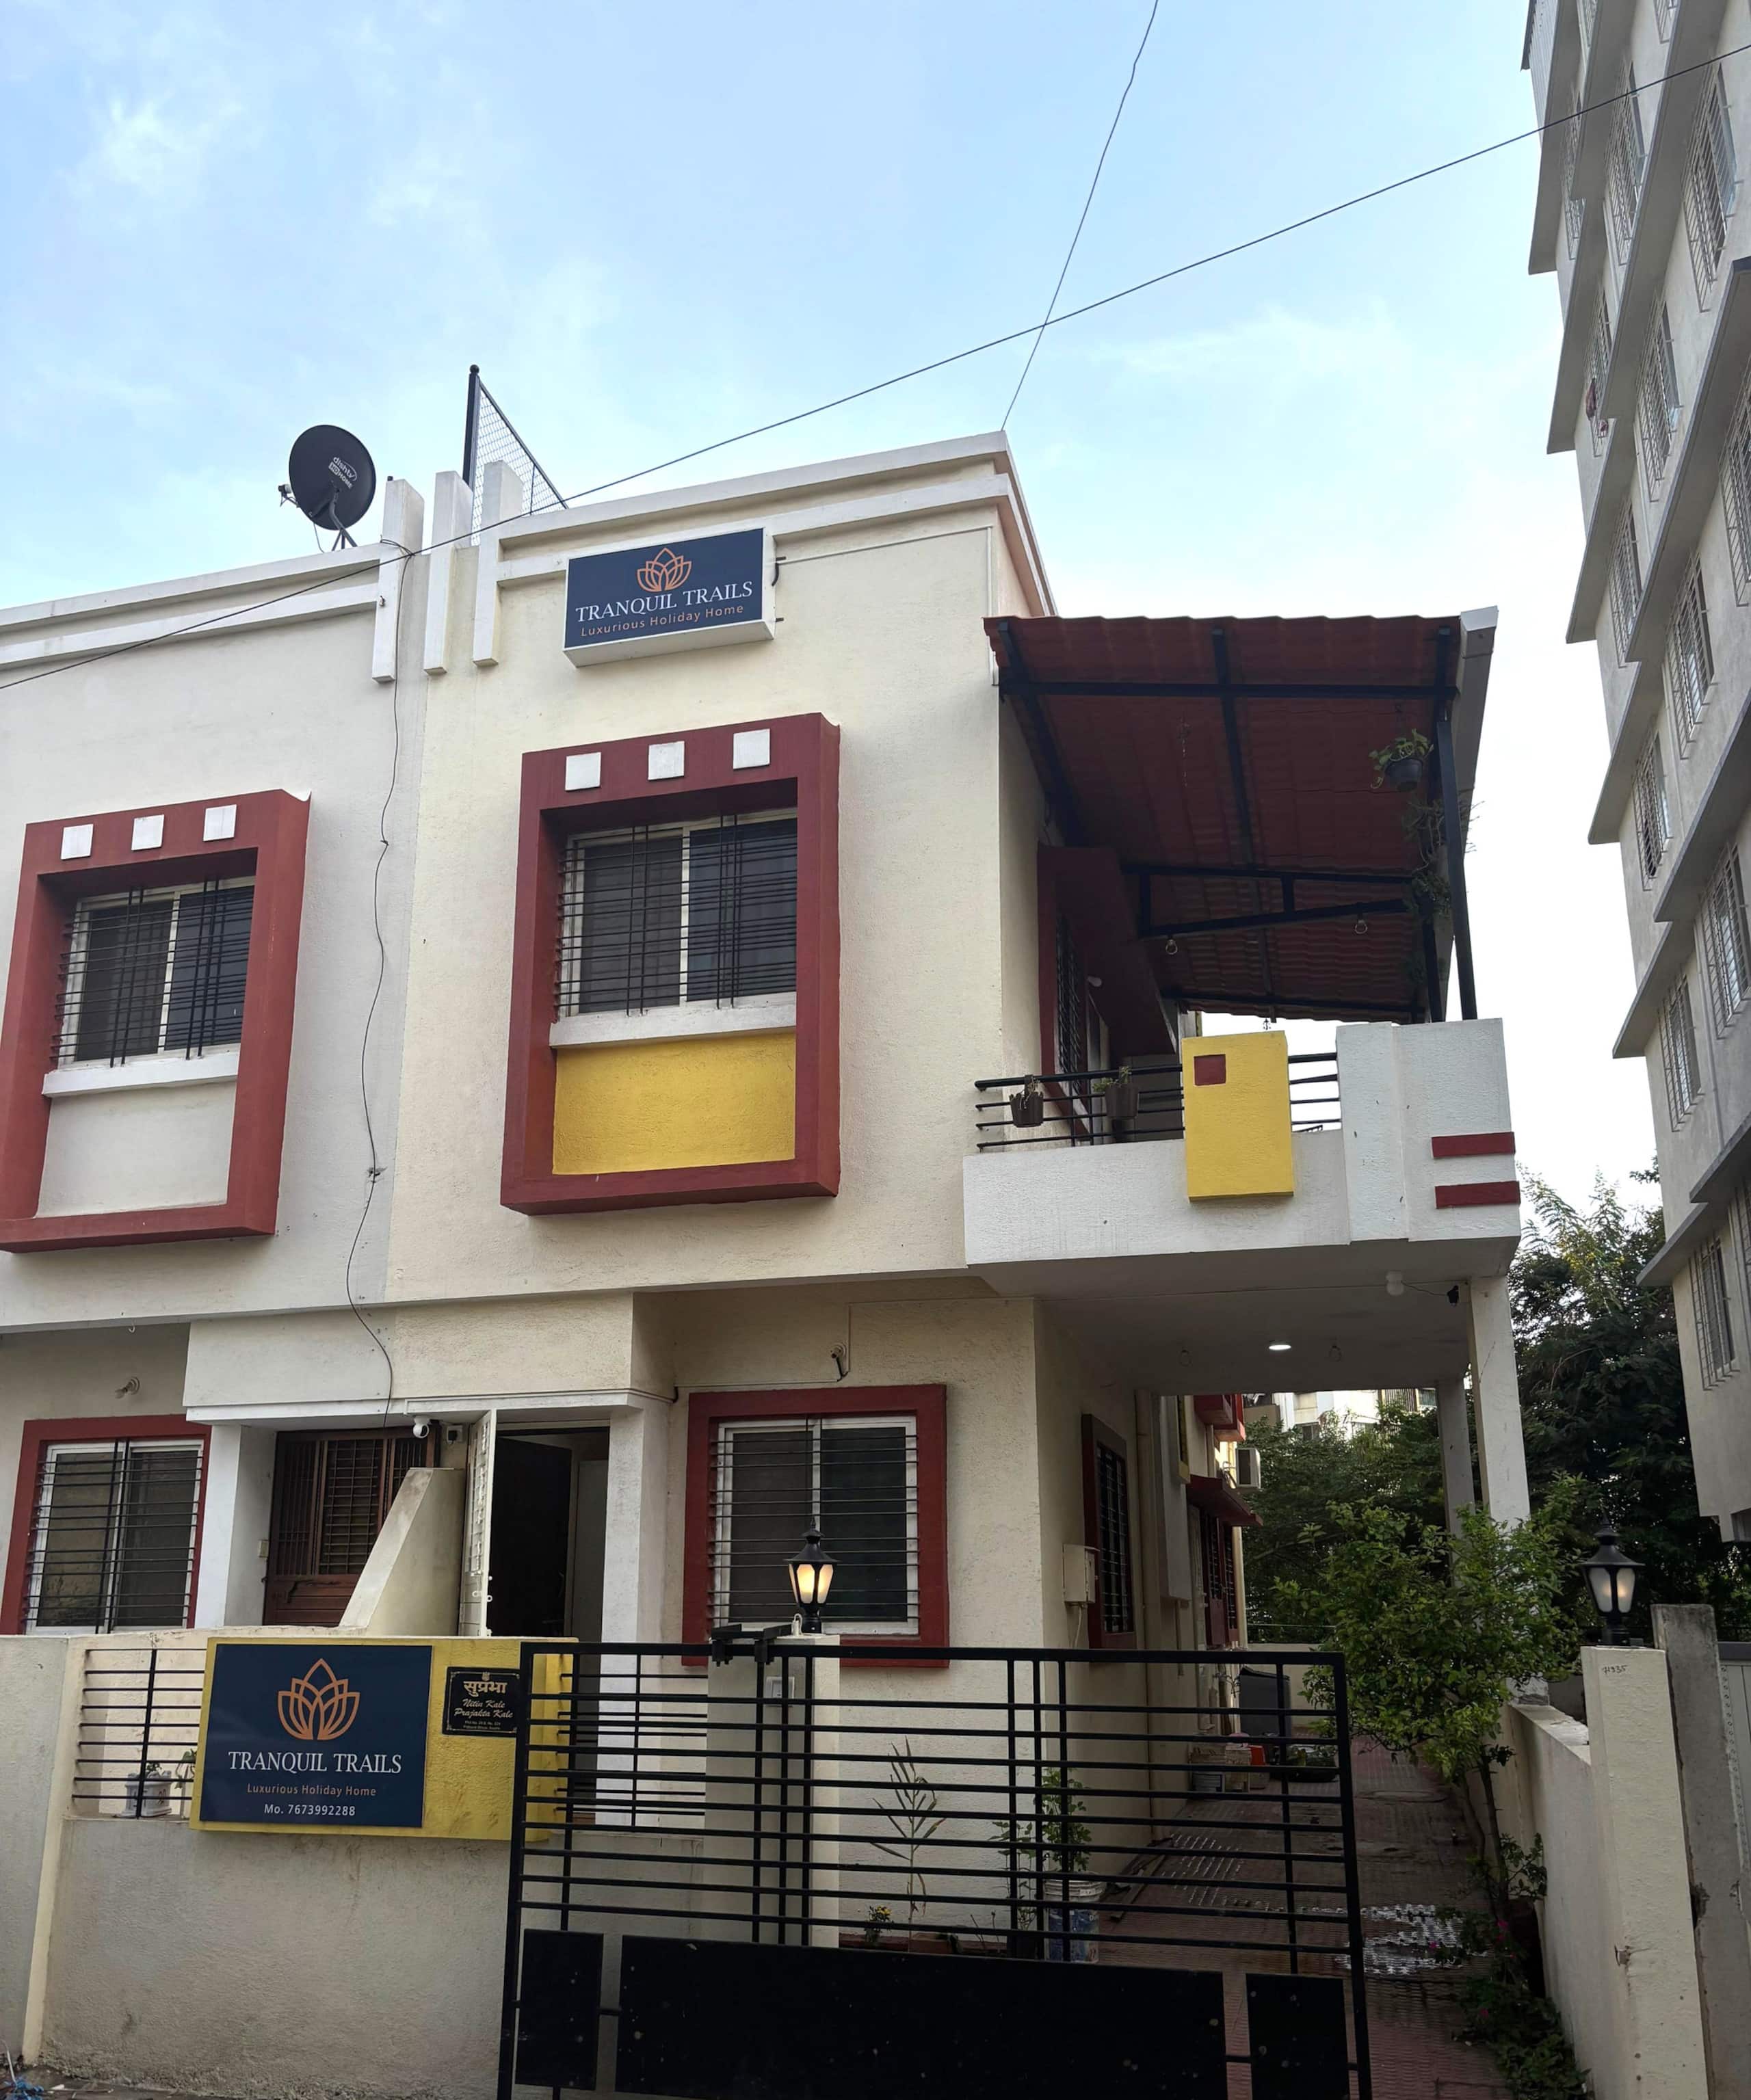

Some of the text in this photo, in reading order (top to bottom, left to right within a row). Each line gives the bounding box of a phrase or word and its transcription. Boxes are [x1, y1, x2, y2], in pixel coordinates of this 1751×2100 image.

[575, 581, 753, 622] TRANQUIL TRAILS
[581, 604, 744, 637] Luxurious Holiday Home
[463, 1681, 508, 1697] सुप्रभा
[462, 1699, 505, 1708] Nitin Kale
[454, 1707, 513, 1718] Prajakta Kale
[228, 1751, 402, 1774] TRANQUIL TRAILS
[247, 1783, 377, 1797] Luxurious Holiday Home
[264, 1804, 356, 1816] Mo. 7673992288
